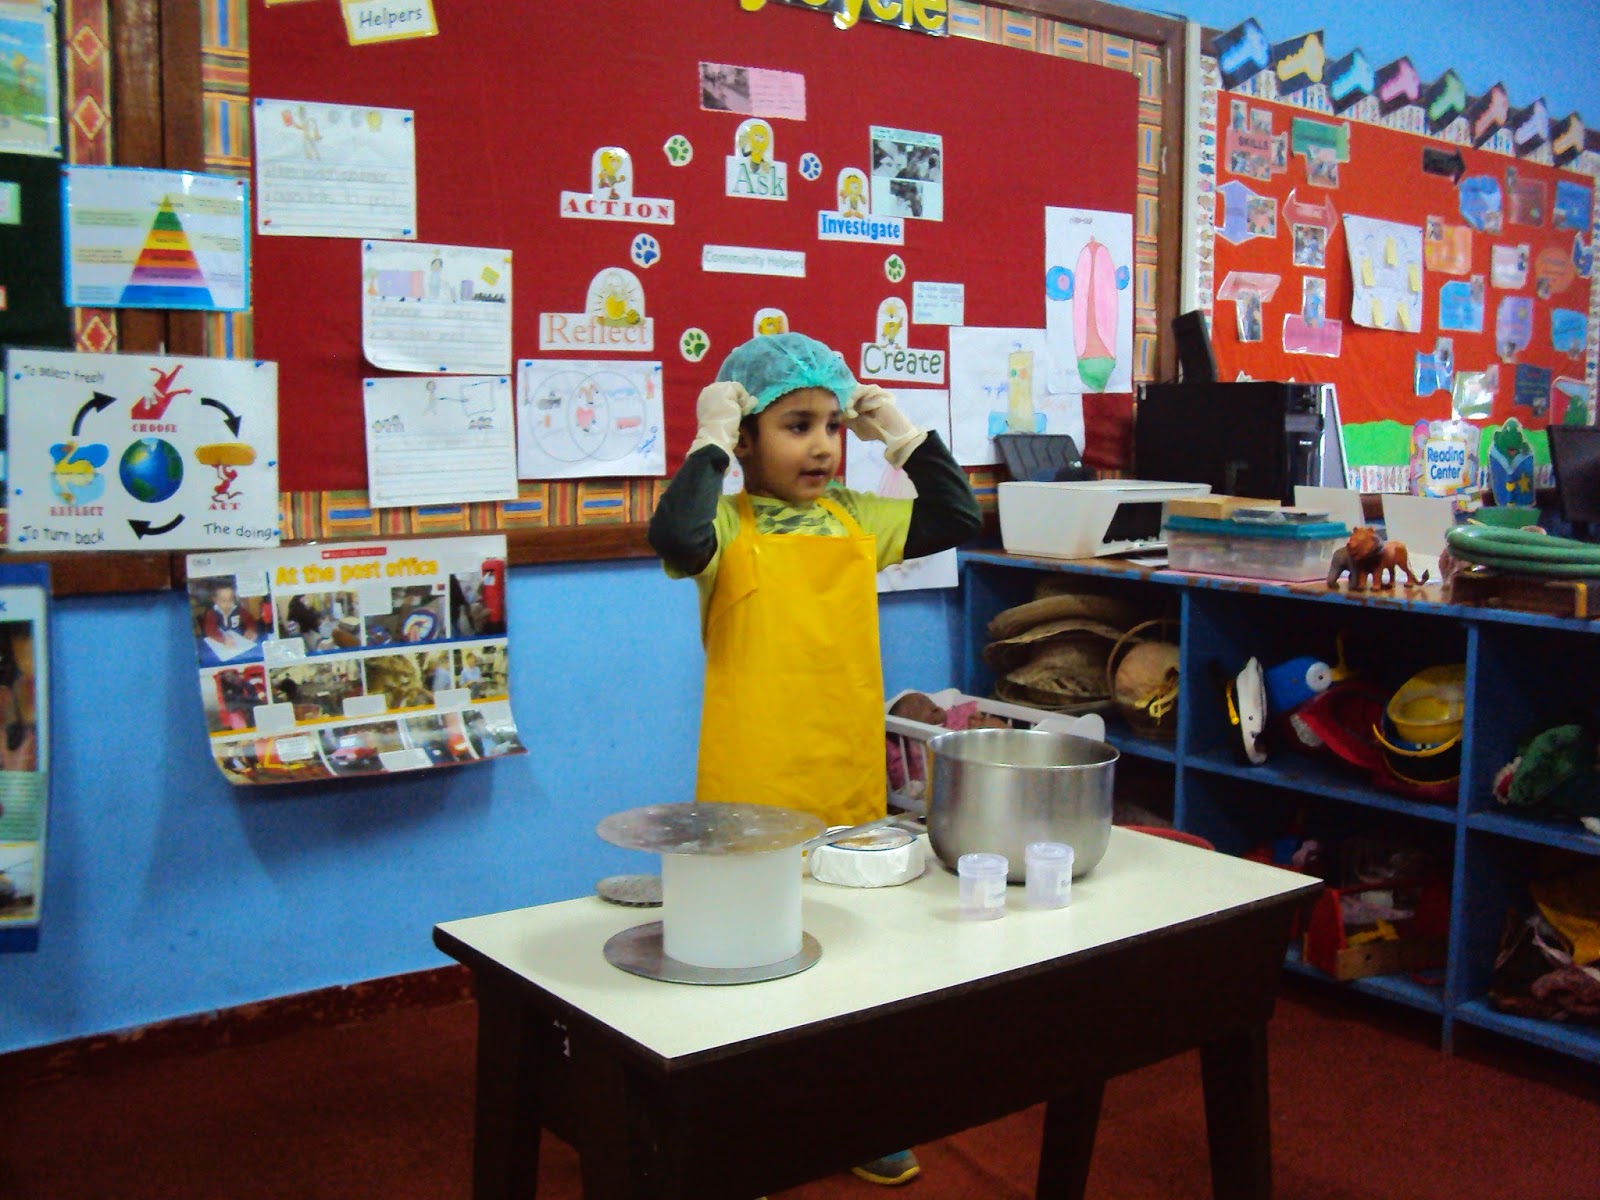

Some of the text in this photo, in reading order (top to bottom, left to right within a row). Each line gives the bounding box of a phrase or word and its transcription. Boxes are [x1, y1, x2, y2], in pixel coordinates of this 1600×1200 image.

[360, 8, 423, 29] Helpers
[732, 162, 785, 197] Ask
[564, 198, 671, 219] ACTION
[821, 213, 900, 241] Investigate
[703, 250, 764, 269] Community
[545, 314, 647, 345] Reflect
[863, 344, 941, 375] Create
[132, 423, 177, 433] CHOOSE
[1427, 446, 1465, 466] Reading
[1430, 464, 1461, 480] Center
[50, 506, 104, 516] REFLECT
[208, 502, 241, 511] ACT
[23, 525, 39, 540] To
[75, 527, 104, 545] back
[203, 522, 272, 541] The doing
[276, 566, 297, 586] At
[302, 562, 334, 584] the
[340, 560, 381, 585] post
[386, 557, 439, 578] office
